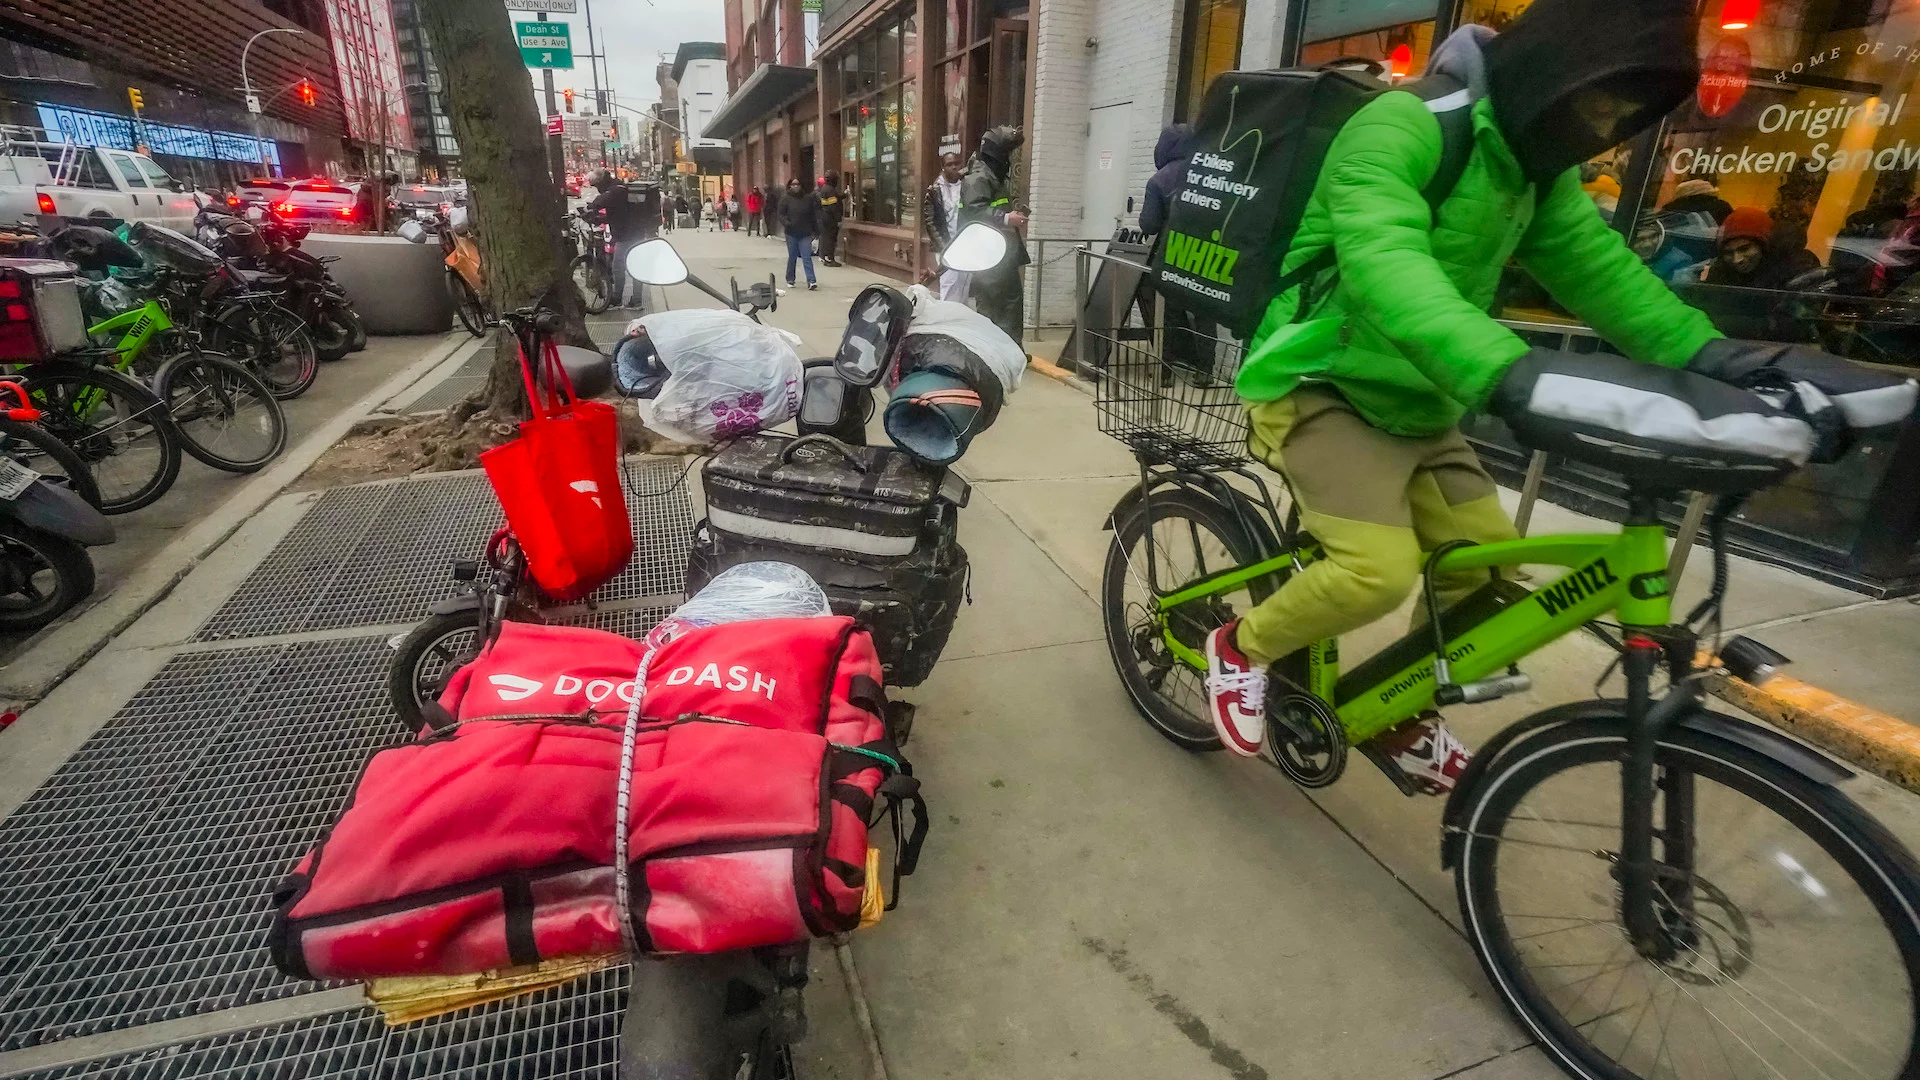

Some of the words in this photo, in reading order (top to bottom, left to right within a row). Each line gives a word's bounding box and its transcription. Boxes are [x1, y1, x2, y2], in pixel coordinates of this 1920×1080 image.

[552, 1, 573, 10] ONLY
[523, 38, 538, 46] Use
[542, 38, 547, 46] 5
[551, 39, 566, 47] Ave
[525, 25, 548, 34] Dean
[551, 25, 560, 34] St
[1774, 47, 1841, 85] HOME
[1856, 42, 1884, 56] OF
[1700, 74, 1726, 89] Pickup
[1727, 76, 1748, 88] Here
[1757, 93, 1908, 139] Original
[1190, 152, 1235, 173] E-bikes
[1670, 145, 1797, 175] Chicken
[1187, 169, 1202, 185] for
[1202, 173, 1260, 200] delivery
[1180, 189, 1222, 211] drivers
[1161, 269, 1231, 302] getwhizz.com
[128, 314, 152, 339] WHIZZ
[1535, 557, 1619, 618] WHIZZ
[553, 663, 777, 701] DOODASH
